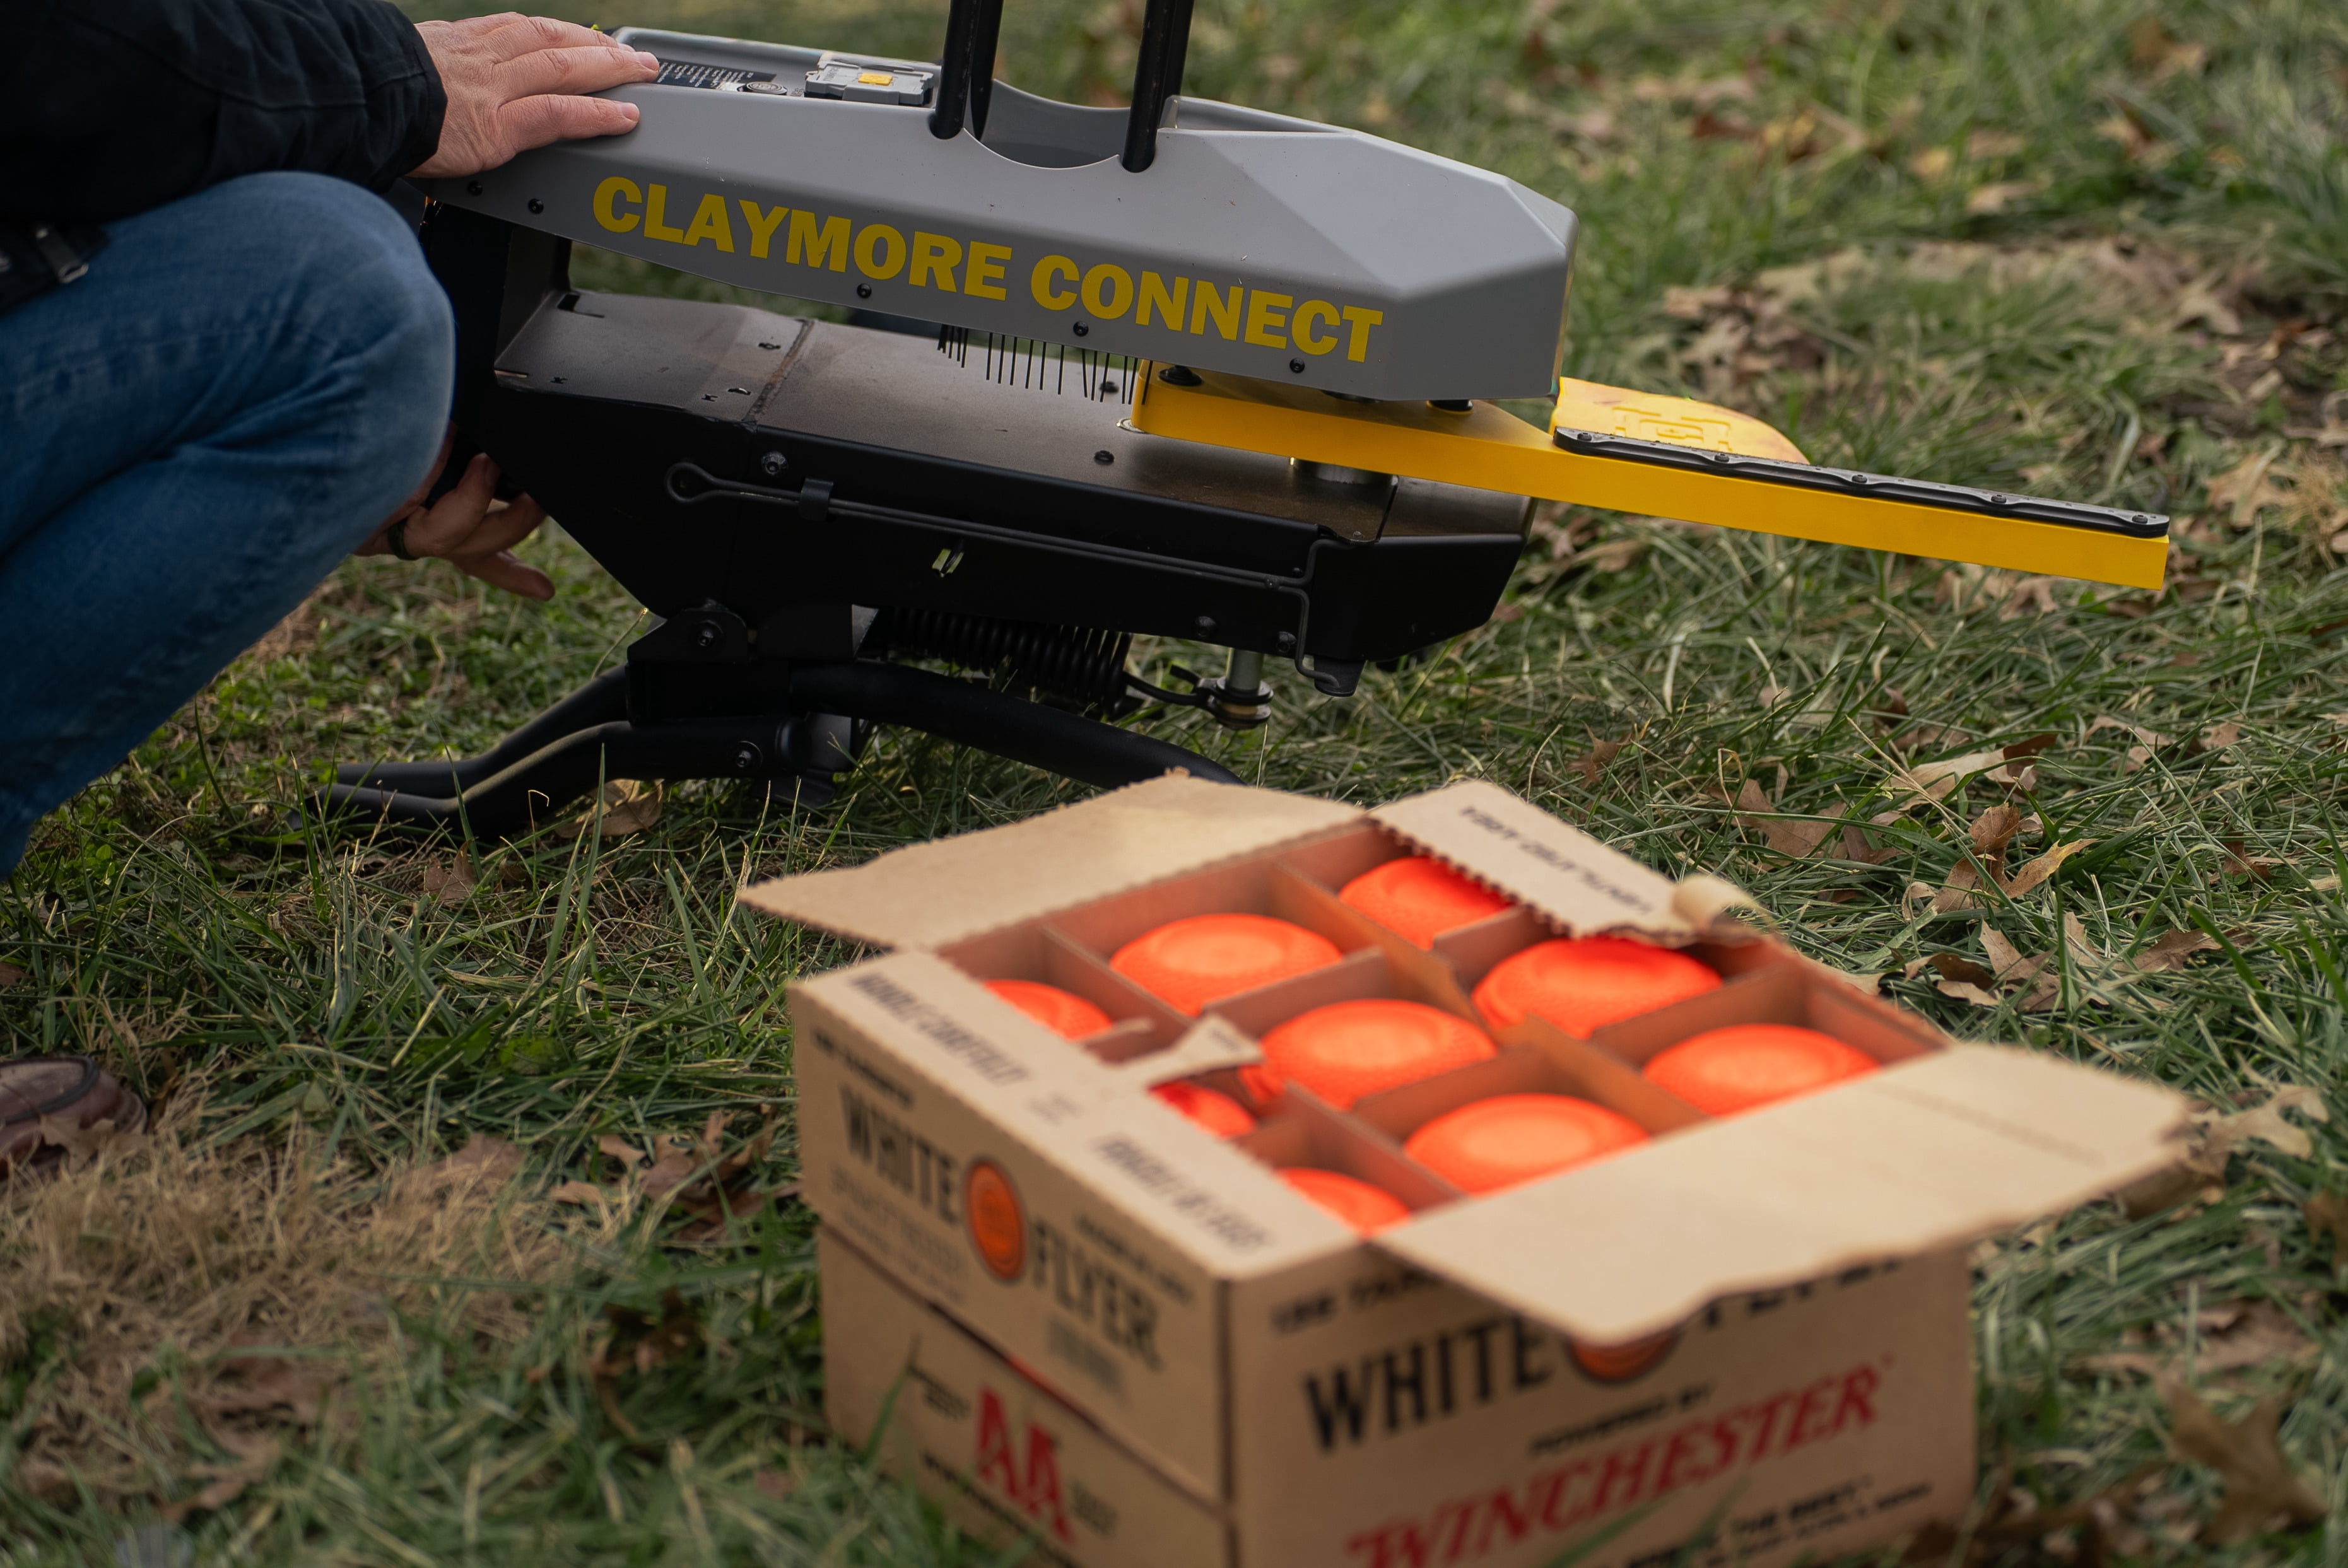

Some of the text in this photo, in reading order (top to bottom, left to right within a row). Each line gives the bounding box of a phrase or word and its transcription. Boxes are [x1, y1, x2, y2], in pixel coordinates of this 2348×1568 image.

[593, 177, 1383, 362] CLAYMORE CONNECT
[840, 1083, 958, 1227] WHITE
[1032, 1219, 1163, 1372] FLYER
[1301, 1313, 1554, 1457] WHITE
[977, 1384, 1076, 1543] AA
[1346, 1362, 1882, 1568] WINCHESTER
